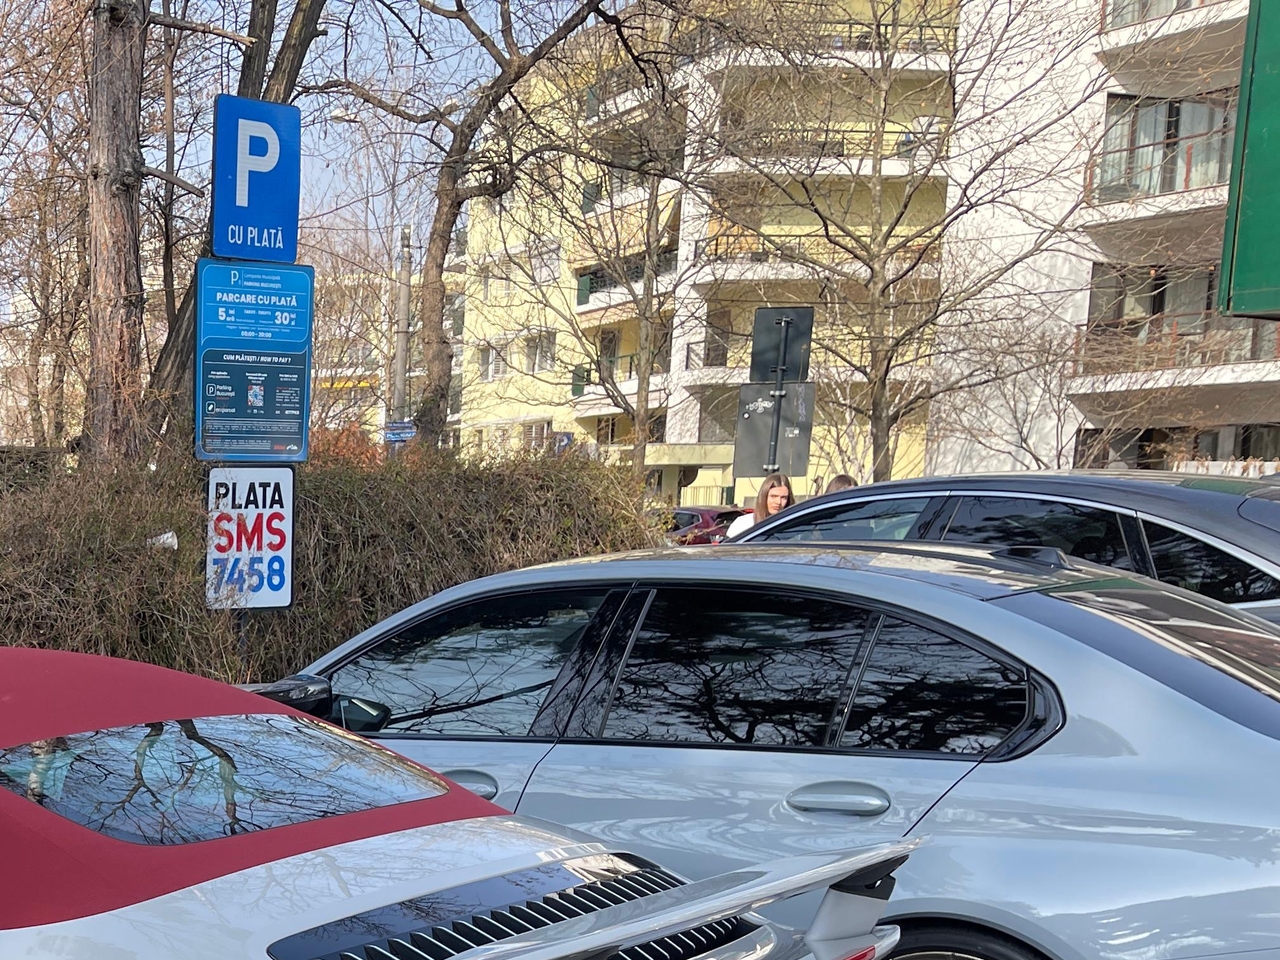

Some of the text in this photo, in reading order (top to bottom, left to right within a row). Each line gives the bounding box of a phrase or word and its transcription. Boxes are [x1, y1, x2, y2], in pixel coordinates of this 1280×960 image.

[235, 118, 280, 207] P
[228, 224, 284, 249] CU PLATĂ
[216, 292, 297, 307] PARCARE CU PLATĂ
[218, 307, 226, 321] 5
[274, 311, 290, 325] 30
[215, 482, 284, 509] PLATA
[213, 511, 286, 553] SMS
[212, 555, 286, 594] 7458
